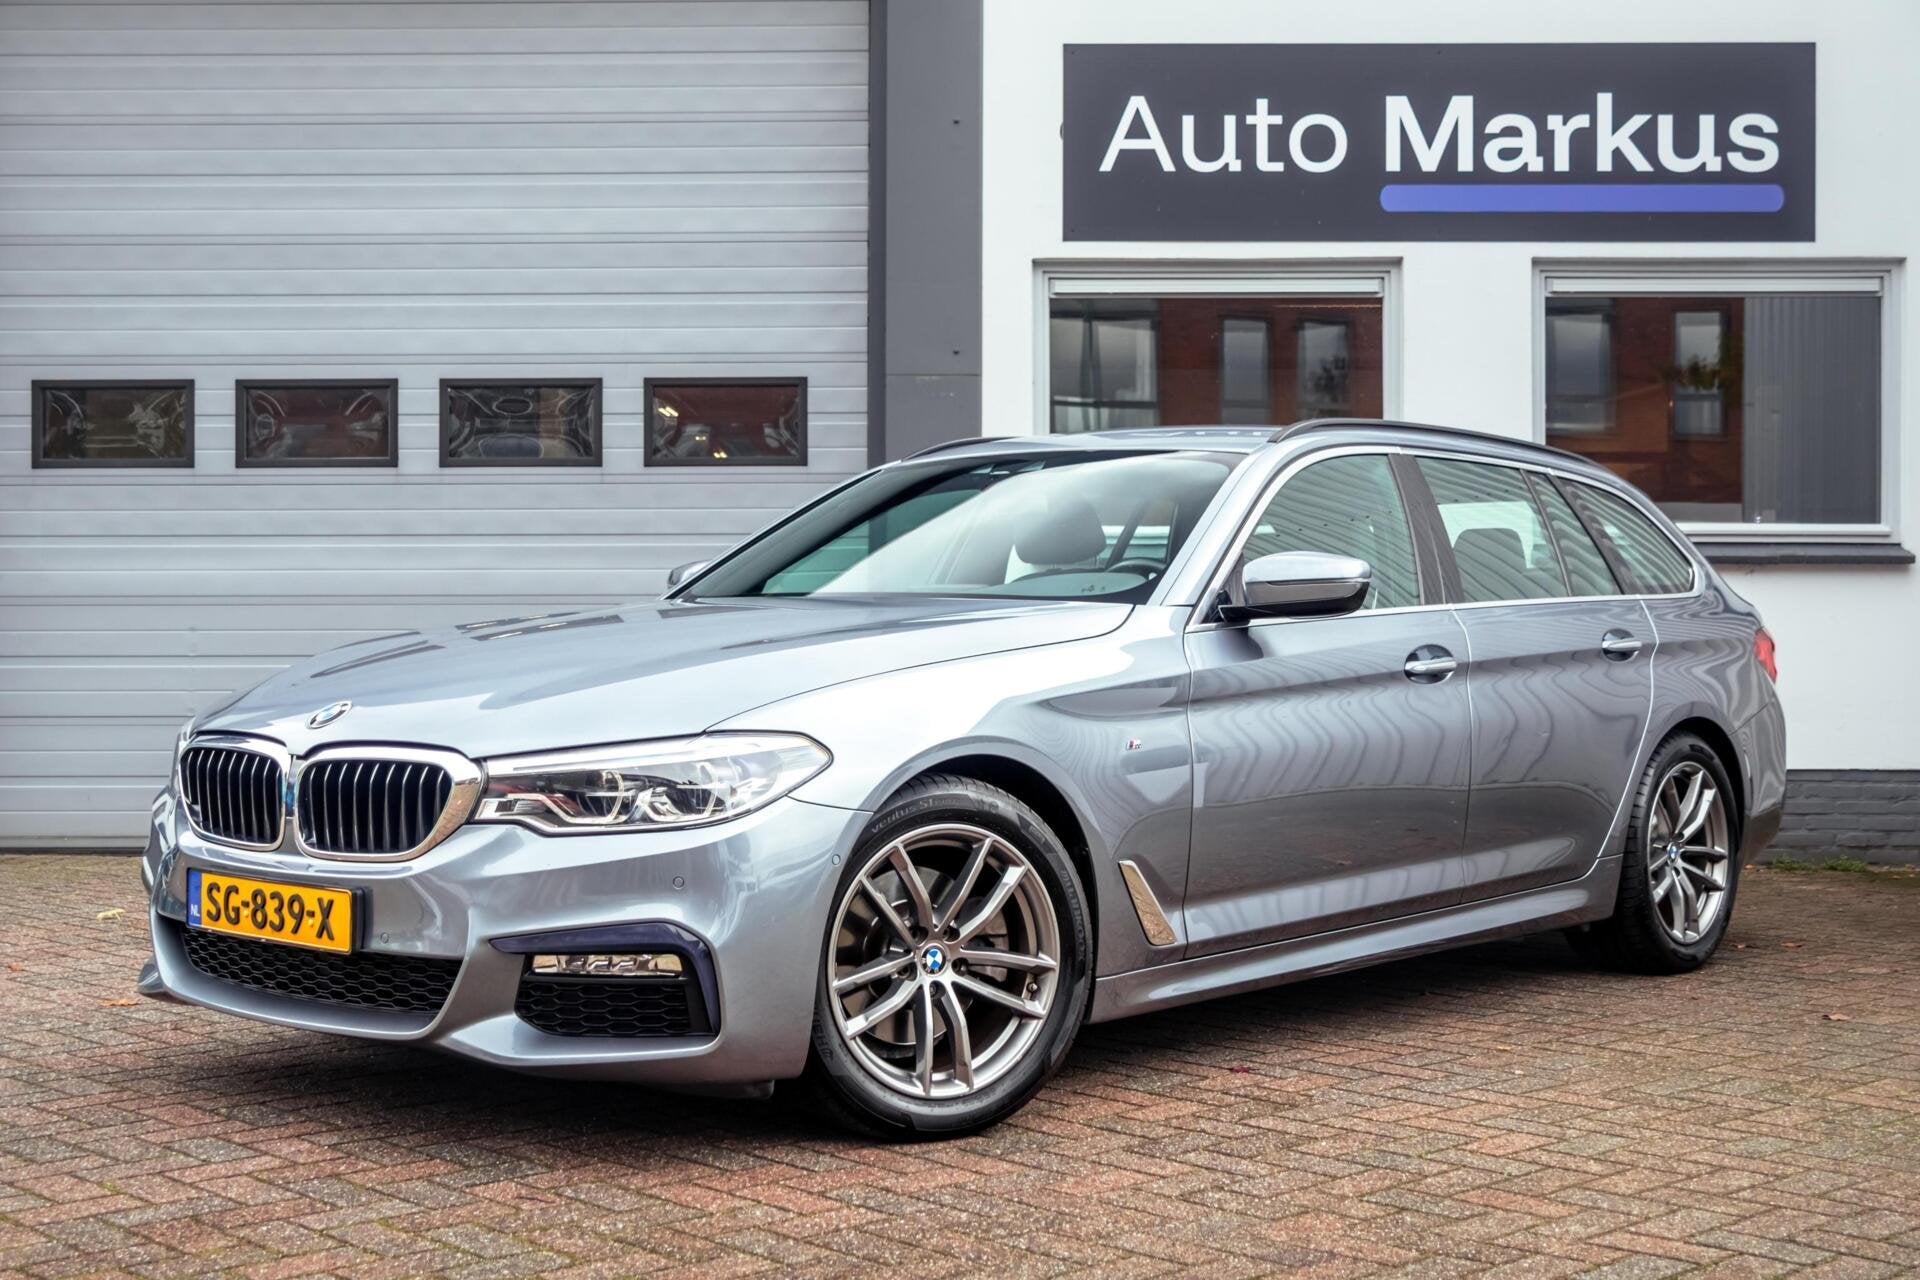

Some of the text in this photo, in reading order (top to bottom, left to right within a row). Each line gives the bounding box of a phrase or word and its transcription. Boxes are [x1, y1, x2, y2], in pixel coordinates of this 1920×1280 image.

[1098, 92, 1779, 173] Auto Markus
[190, 903, 201, 918] NL
[206, 882, 335, 941] SG-839-X
